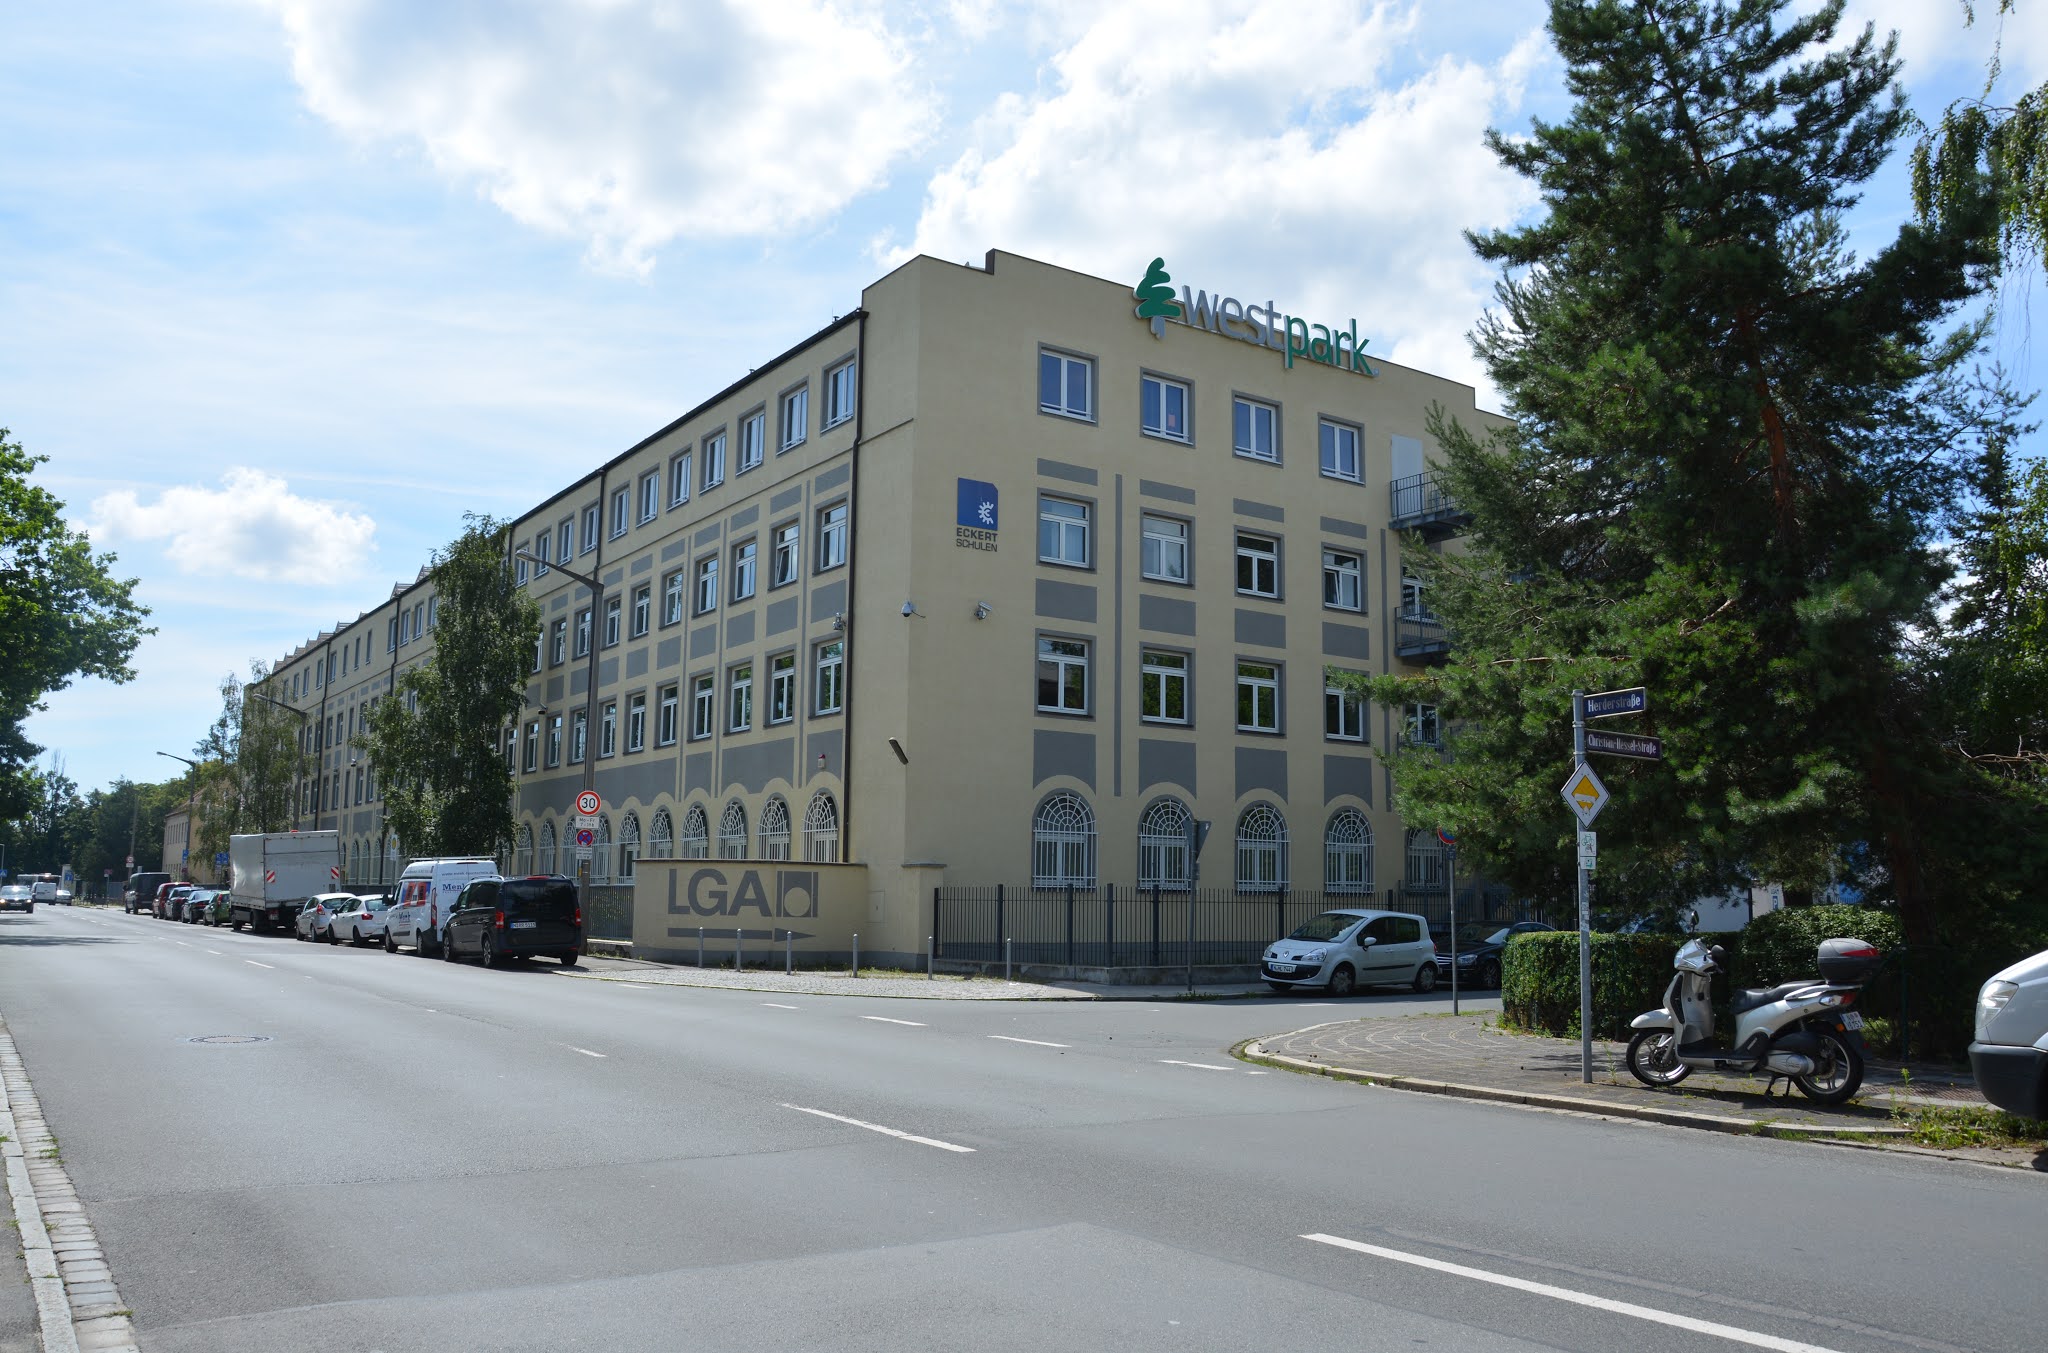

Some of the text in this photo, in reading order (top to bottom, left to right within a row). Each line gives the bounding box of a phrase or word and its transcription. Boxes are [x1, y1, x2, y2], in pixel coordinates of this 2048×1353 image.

[1182, 285, 1374, 376] westpark
[956, 527, 998, 542] ECKERT
[956, 538, 998, 552] SCHULEN
[1587, 693, 1641, 713] Herderstraße
[1588, 733, 1657, 755] Christian-Hessel-Straße
[581, 797, 596, 809] 30
[667, 868, 772, 917] LGA
